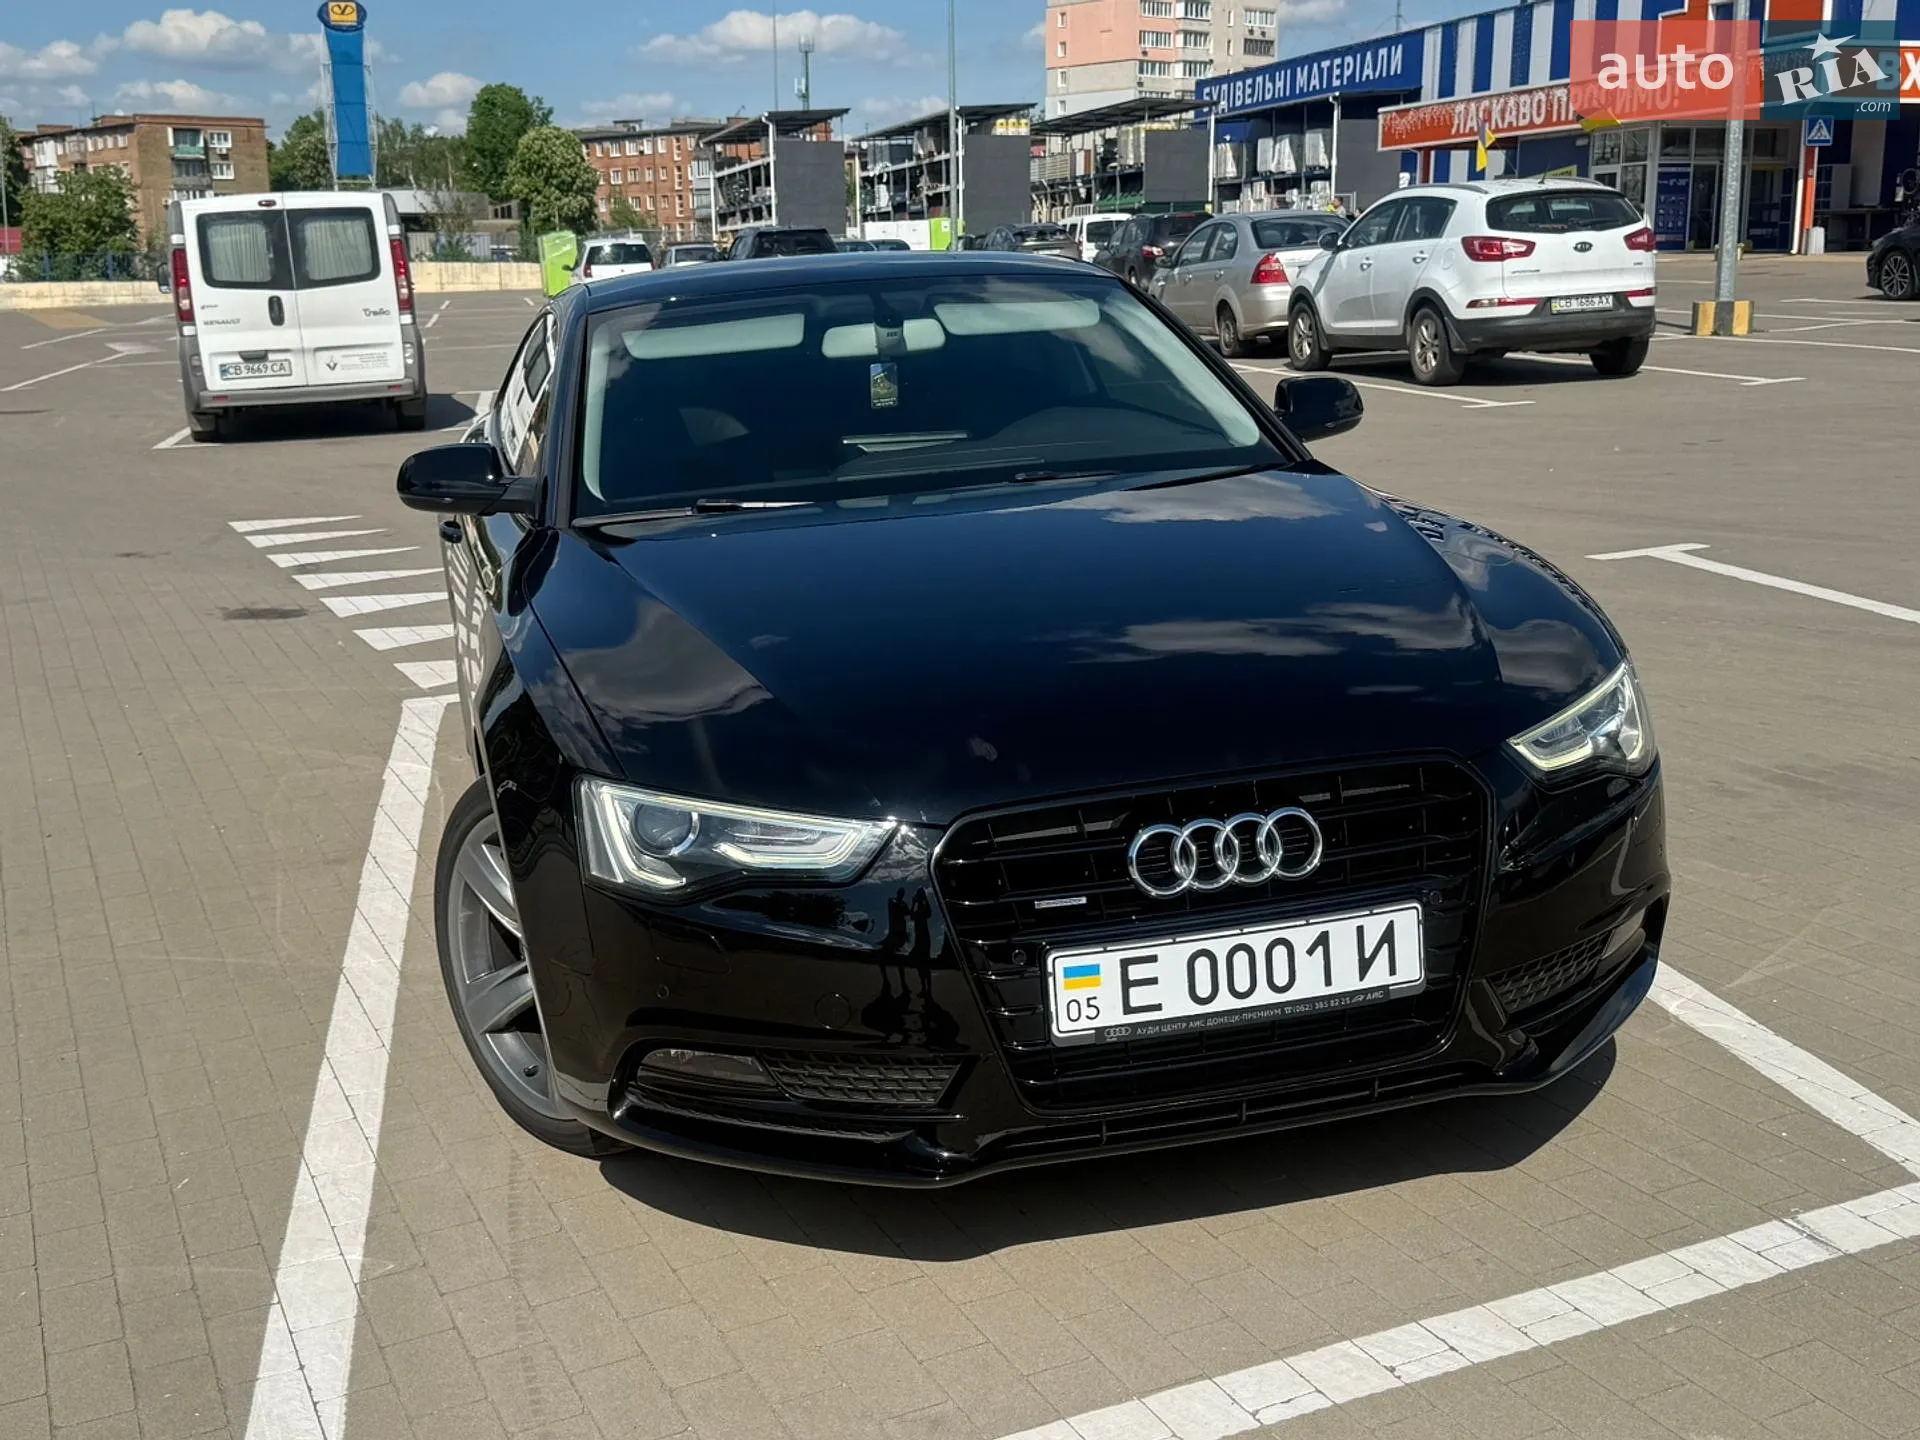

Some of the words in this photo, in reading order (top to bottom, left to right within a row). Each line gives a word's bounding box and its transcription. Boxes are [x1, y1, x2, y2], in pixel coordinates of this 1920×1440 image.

[1295, 43, 1404, 95] МАТЕРІАЛИ
[1451, 90, 1547, 135] ЛАСКАВО
[244, 363, 269, 375] 9669
[1186, 930, 1333, 1006] 0001
[1356, 919, 1397, 983] И
[1066, 996, 1100, 1023] 05
